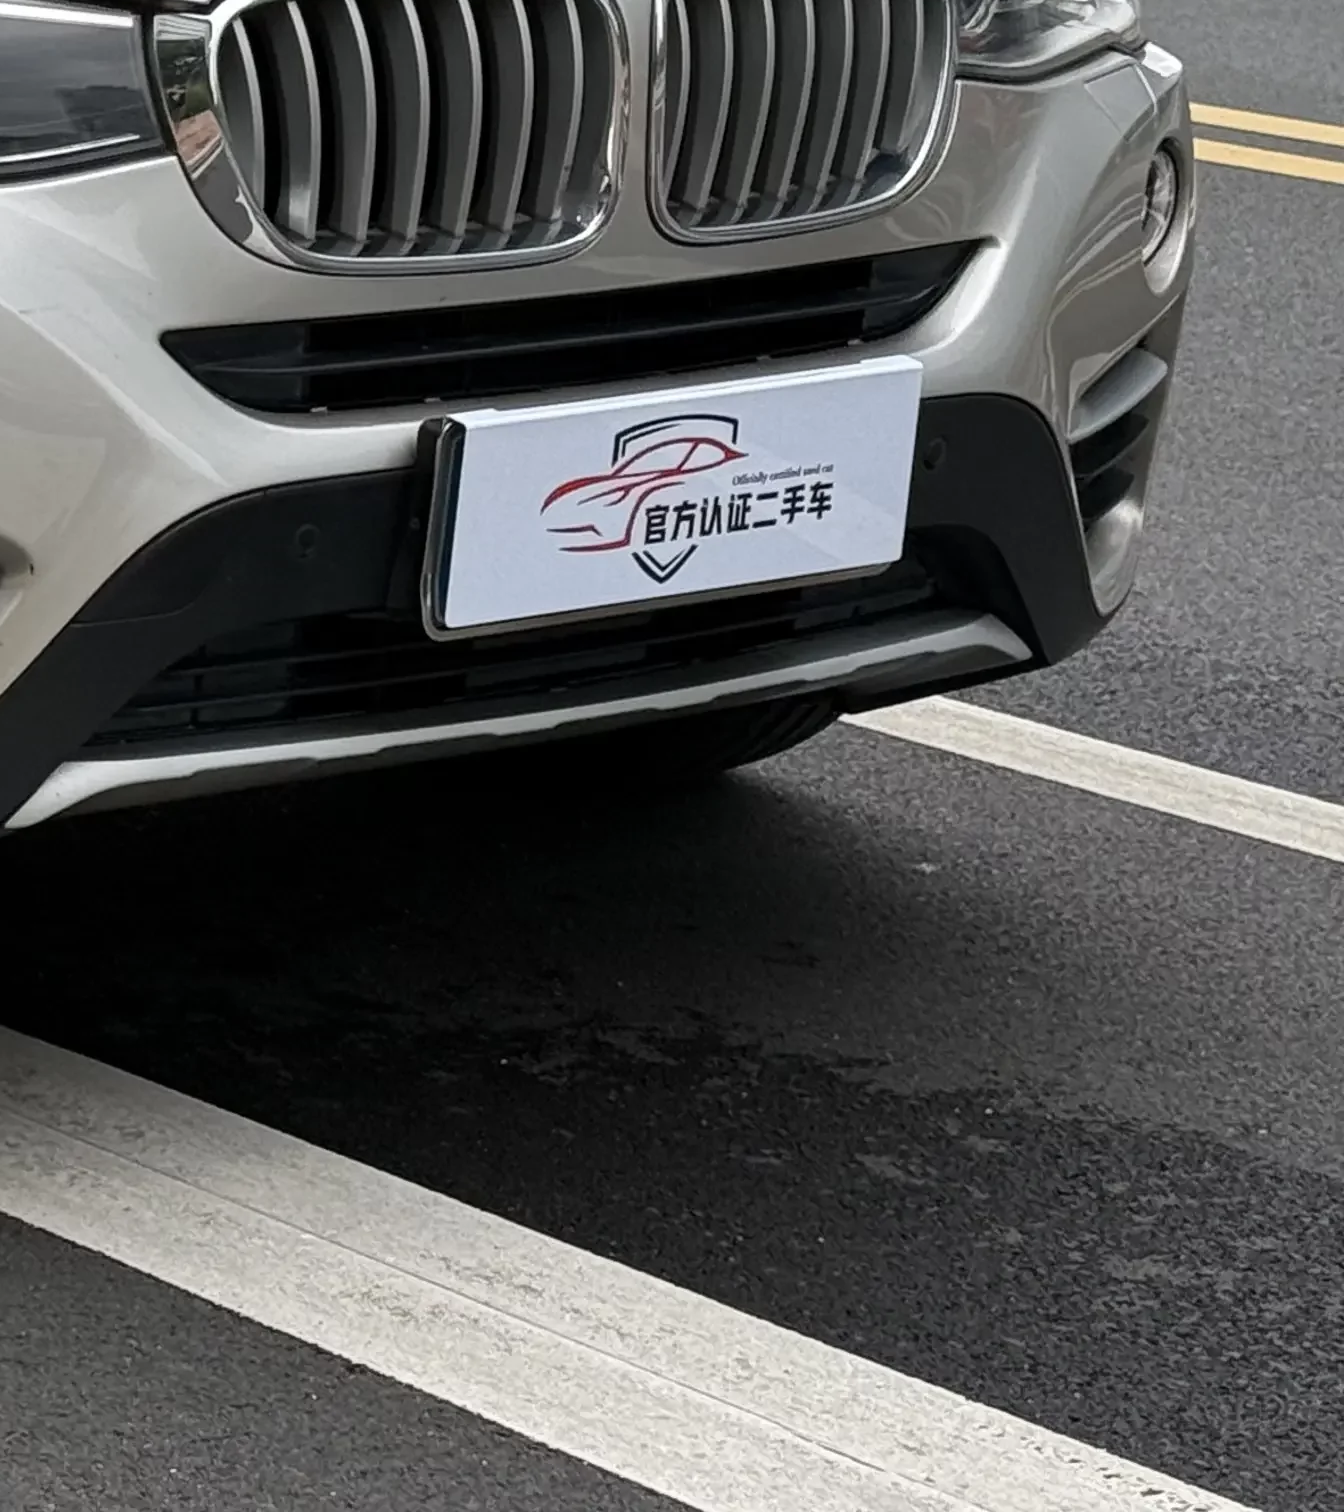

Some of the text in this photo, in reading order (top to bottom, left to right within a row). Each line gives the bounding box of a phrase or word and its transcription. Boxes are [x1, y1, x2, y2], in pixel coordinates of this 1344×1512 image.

[644, 481, 834, 545] 官方认证二手车
